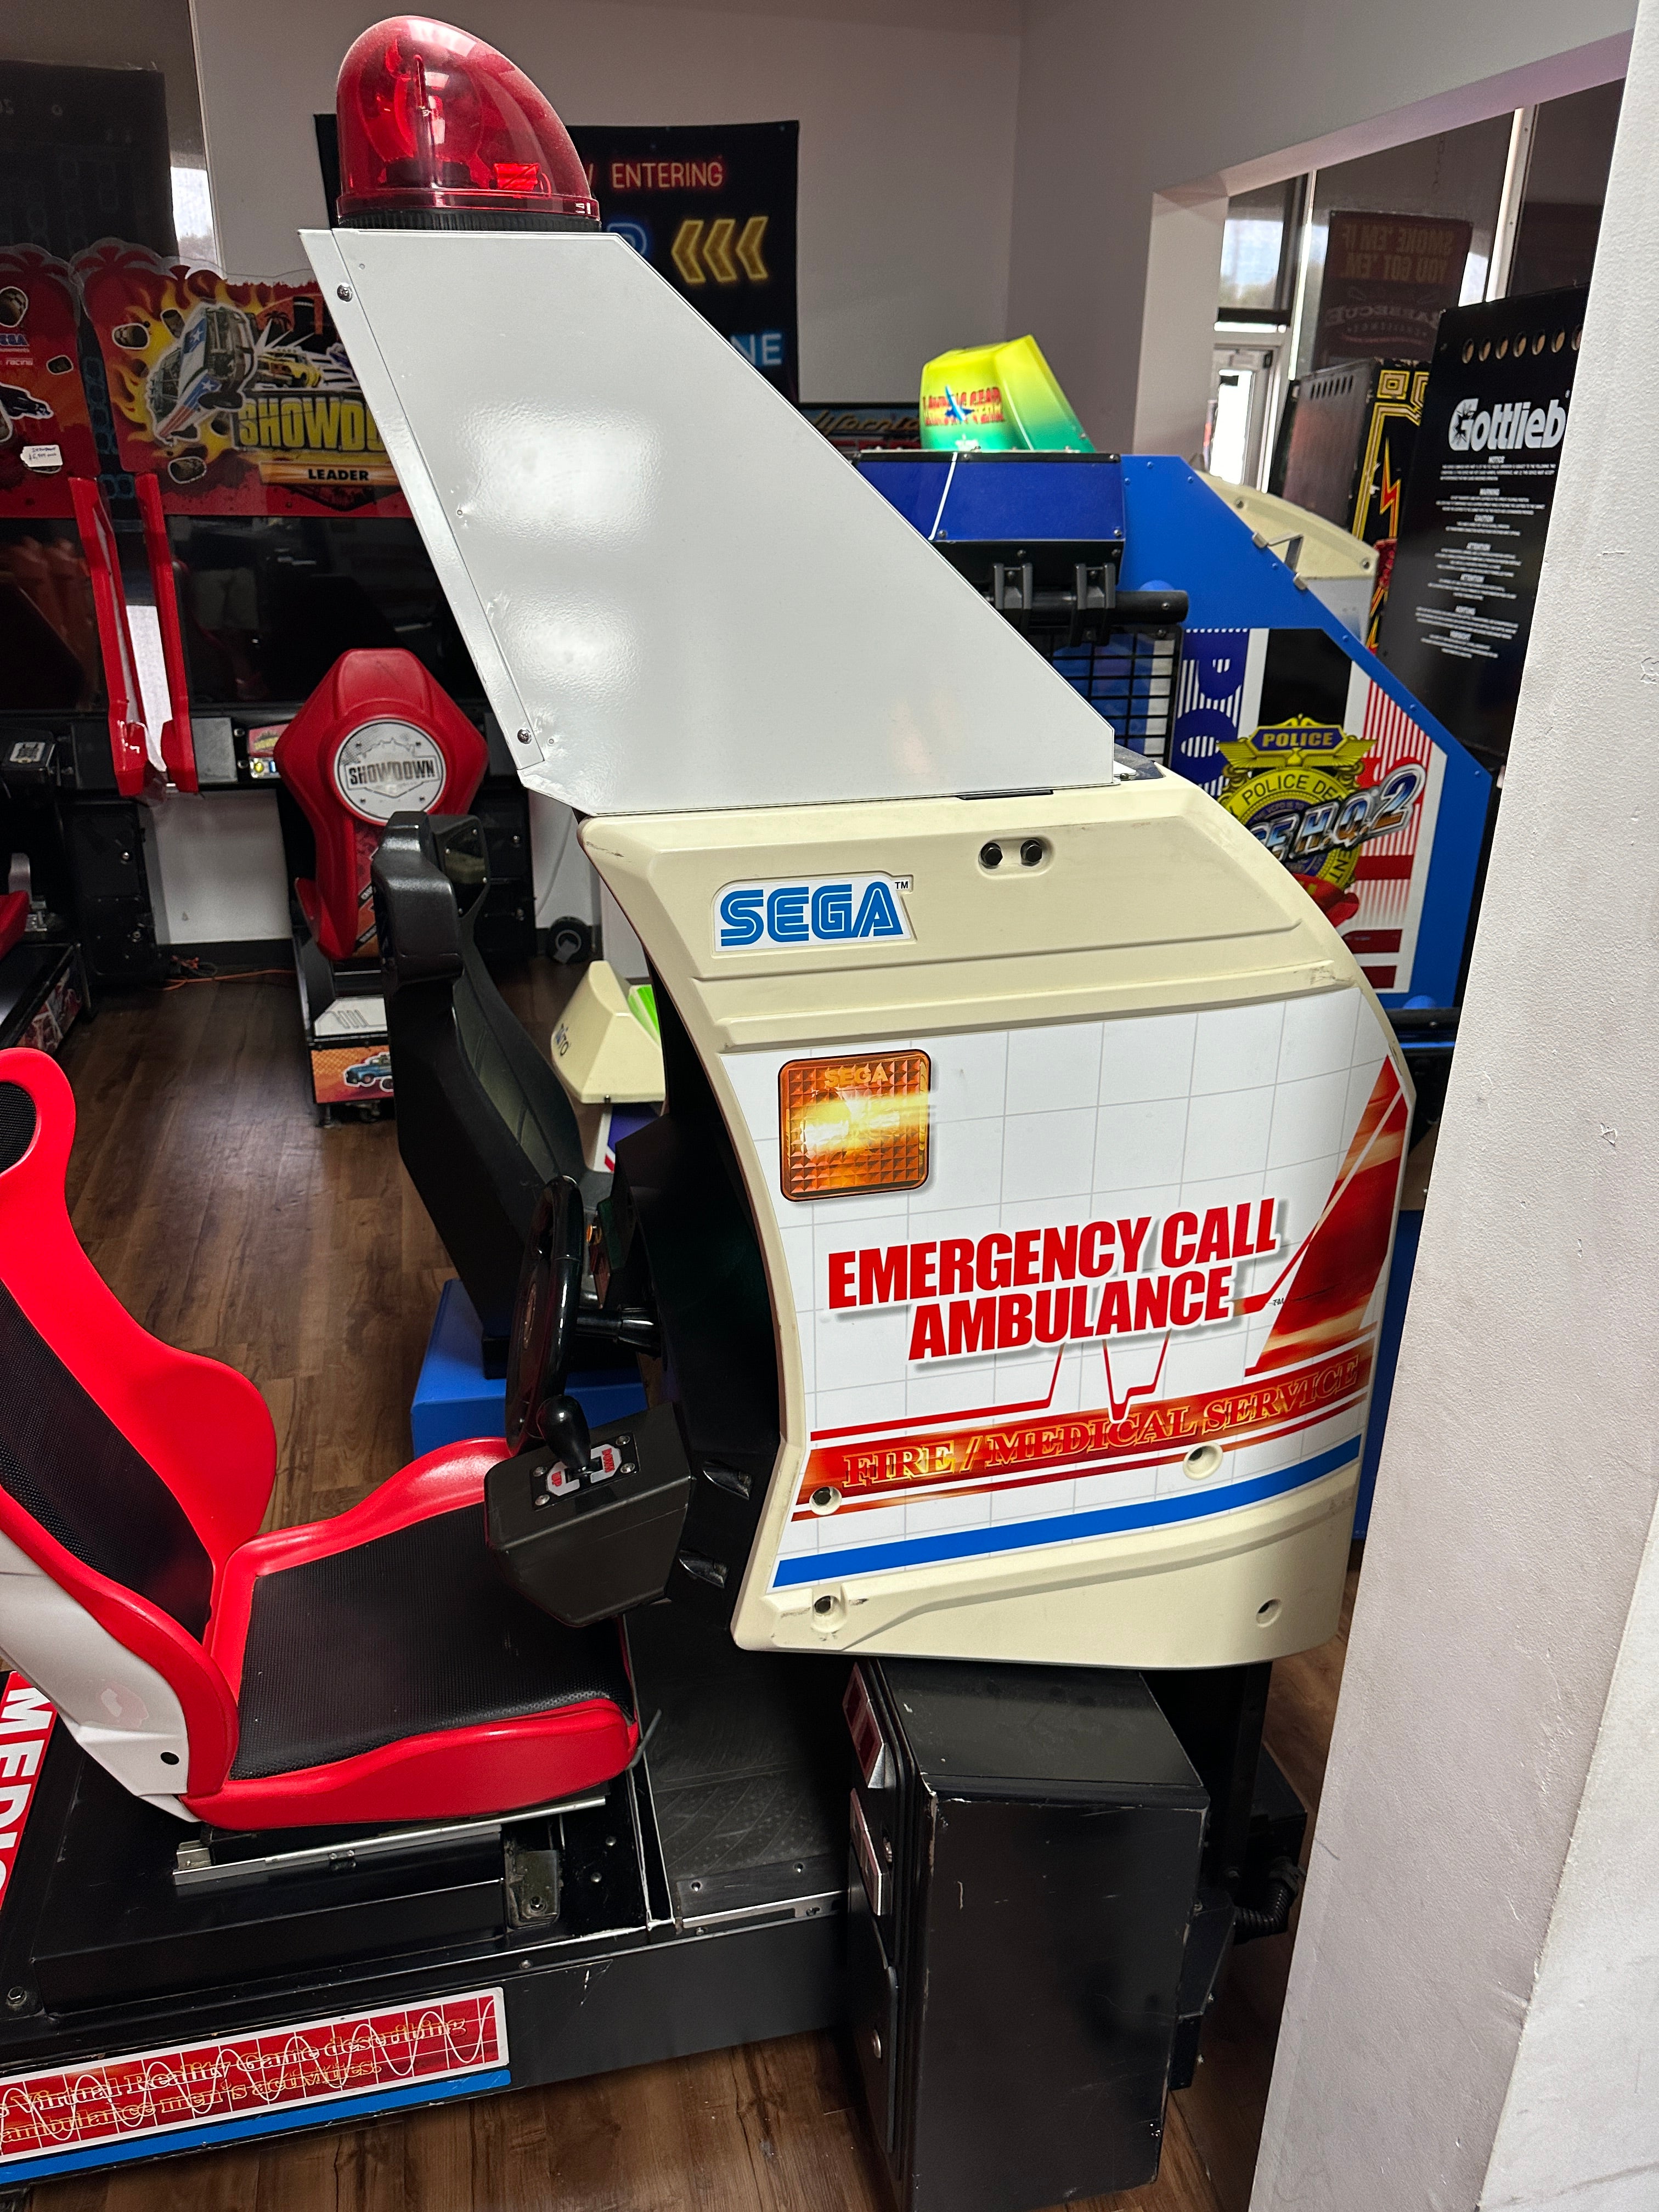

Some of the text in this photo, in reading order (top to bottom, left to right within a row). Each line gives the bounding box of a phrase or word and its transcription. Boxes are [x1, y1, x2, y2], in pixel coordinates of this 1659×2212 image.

[612, 162, 723, 188] ENTERING
[730, 334, 781, 365] NE
[1448, 398, 1566, 452] Gottlieb
[308, 469, 369, 481] LEADER
[1262, 732, 1333, 747] POLICE
[348, 759, 435, 785] SHOWDOWN
[1242, 774, 1310, 805] POLICE
[720, 881, 909, 946] SEGA TM
[825, 1063, 889, 1088] SEGA
[829, 1198, 1276, 1309] EMERGENCY CALL
[909, 1266, 1232, 1361] AMBULANCE
[842, 1440, 955, 1488] FIRE
[985, 1406, 1197, 1468] MEDICAL
[1202, 1355, 1360, 1435] SERVICE
[602, 1448, 615, 1473] DOWN
[551, 1471, 562, 1487] UP
[10, 2078, 122, 2114] Virtual
[123, 2061, 231, 2094] Reality
[236, 2048, 319, 2072] Game
[324, 2018, 466, 2057] describing
[1, 2102, 156, 2143] ambulance
